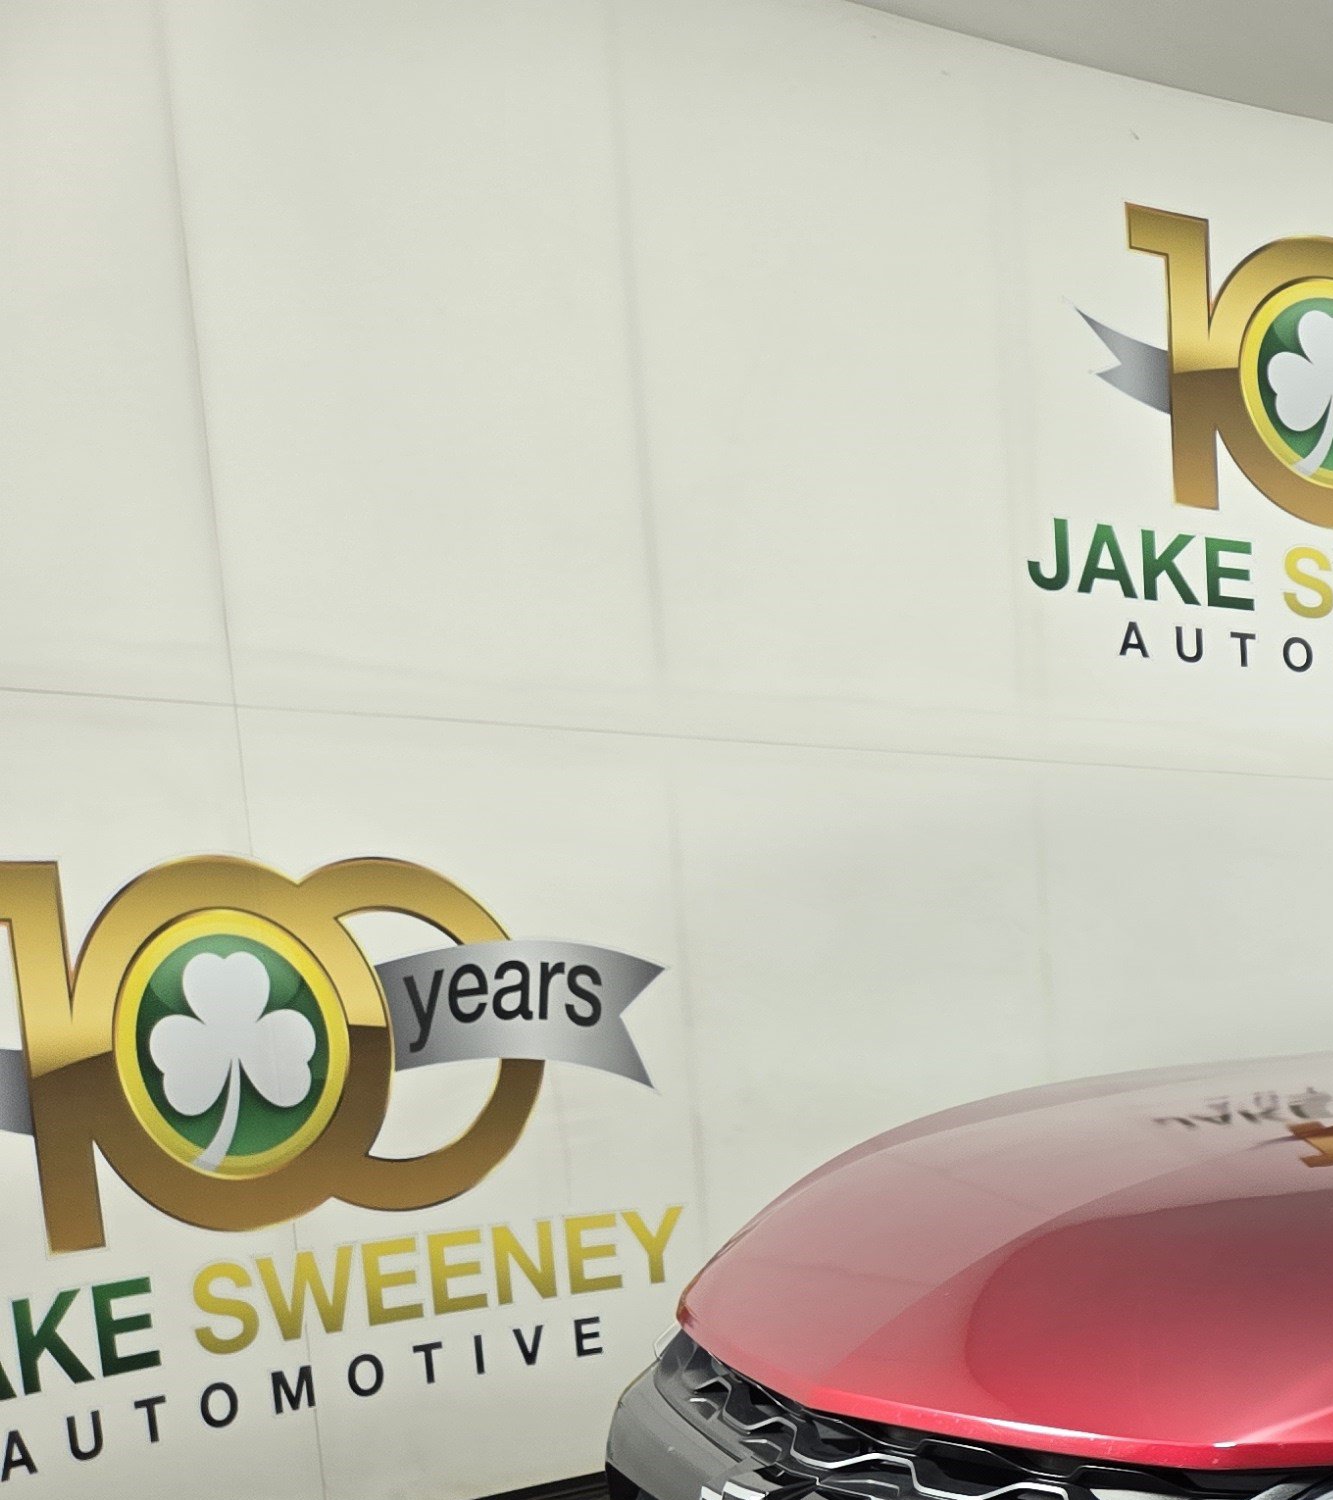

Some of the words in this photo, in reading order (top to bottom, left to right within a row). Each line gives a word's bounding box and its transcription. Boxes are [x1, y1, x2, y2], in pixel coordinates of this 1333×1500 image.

[1026, 517, 1255, 612] JAKE
[0, 855, 546, 1254] 100
[402, 956, 604, 1053] years
[0, 1276, 163, 1397] KE
[192, 1205, 684, 1356] SWEENEY
[0, 1316, 605, 1484] AUTOMOTIVE
